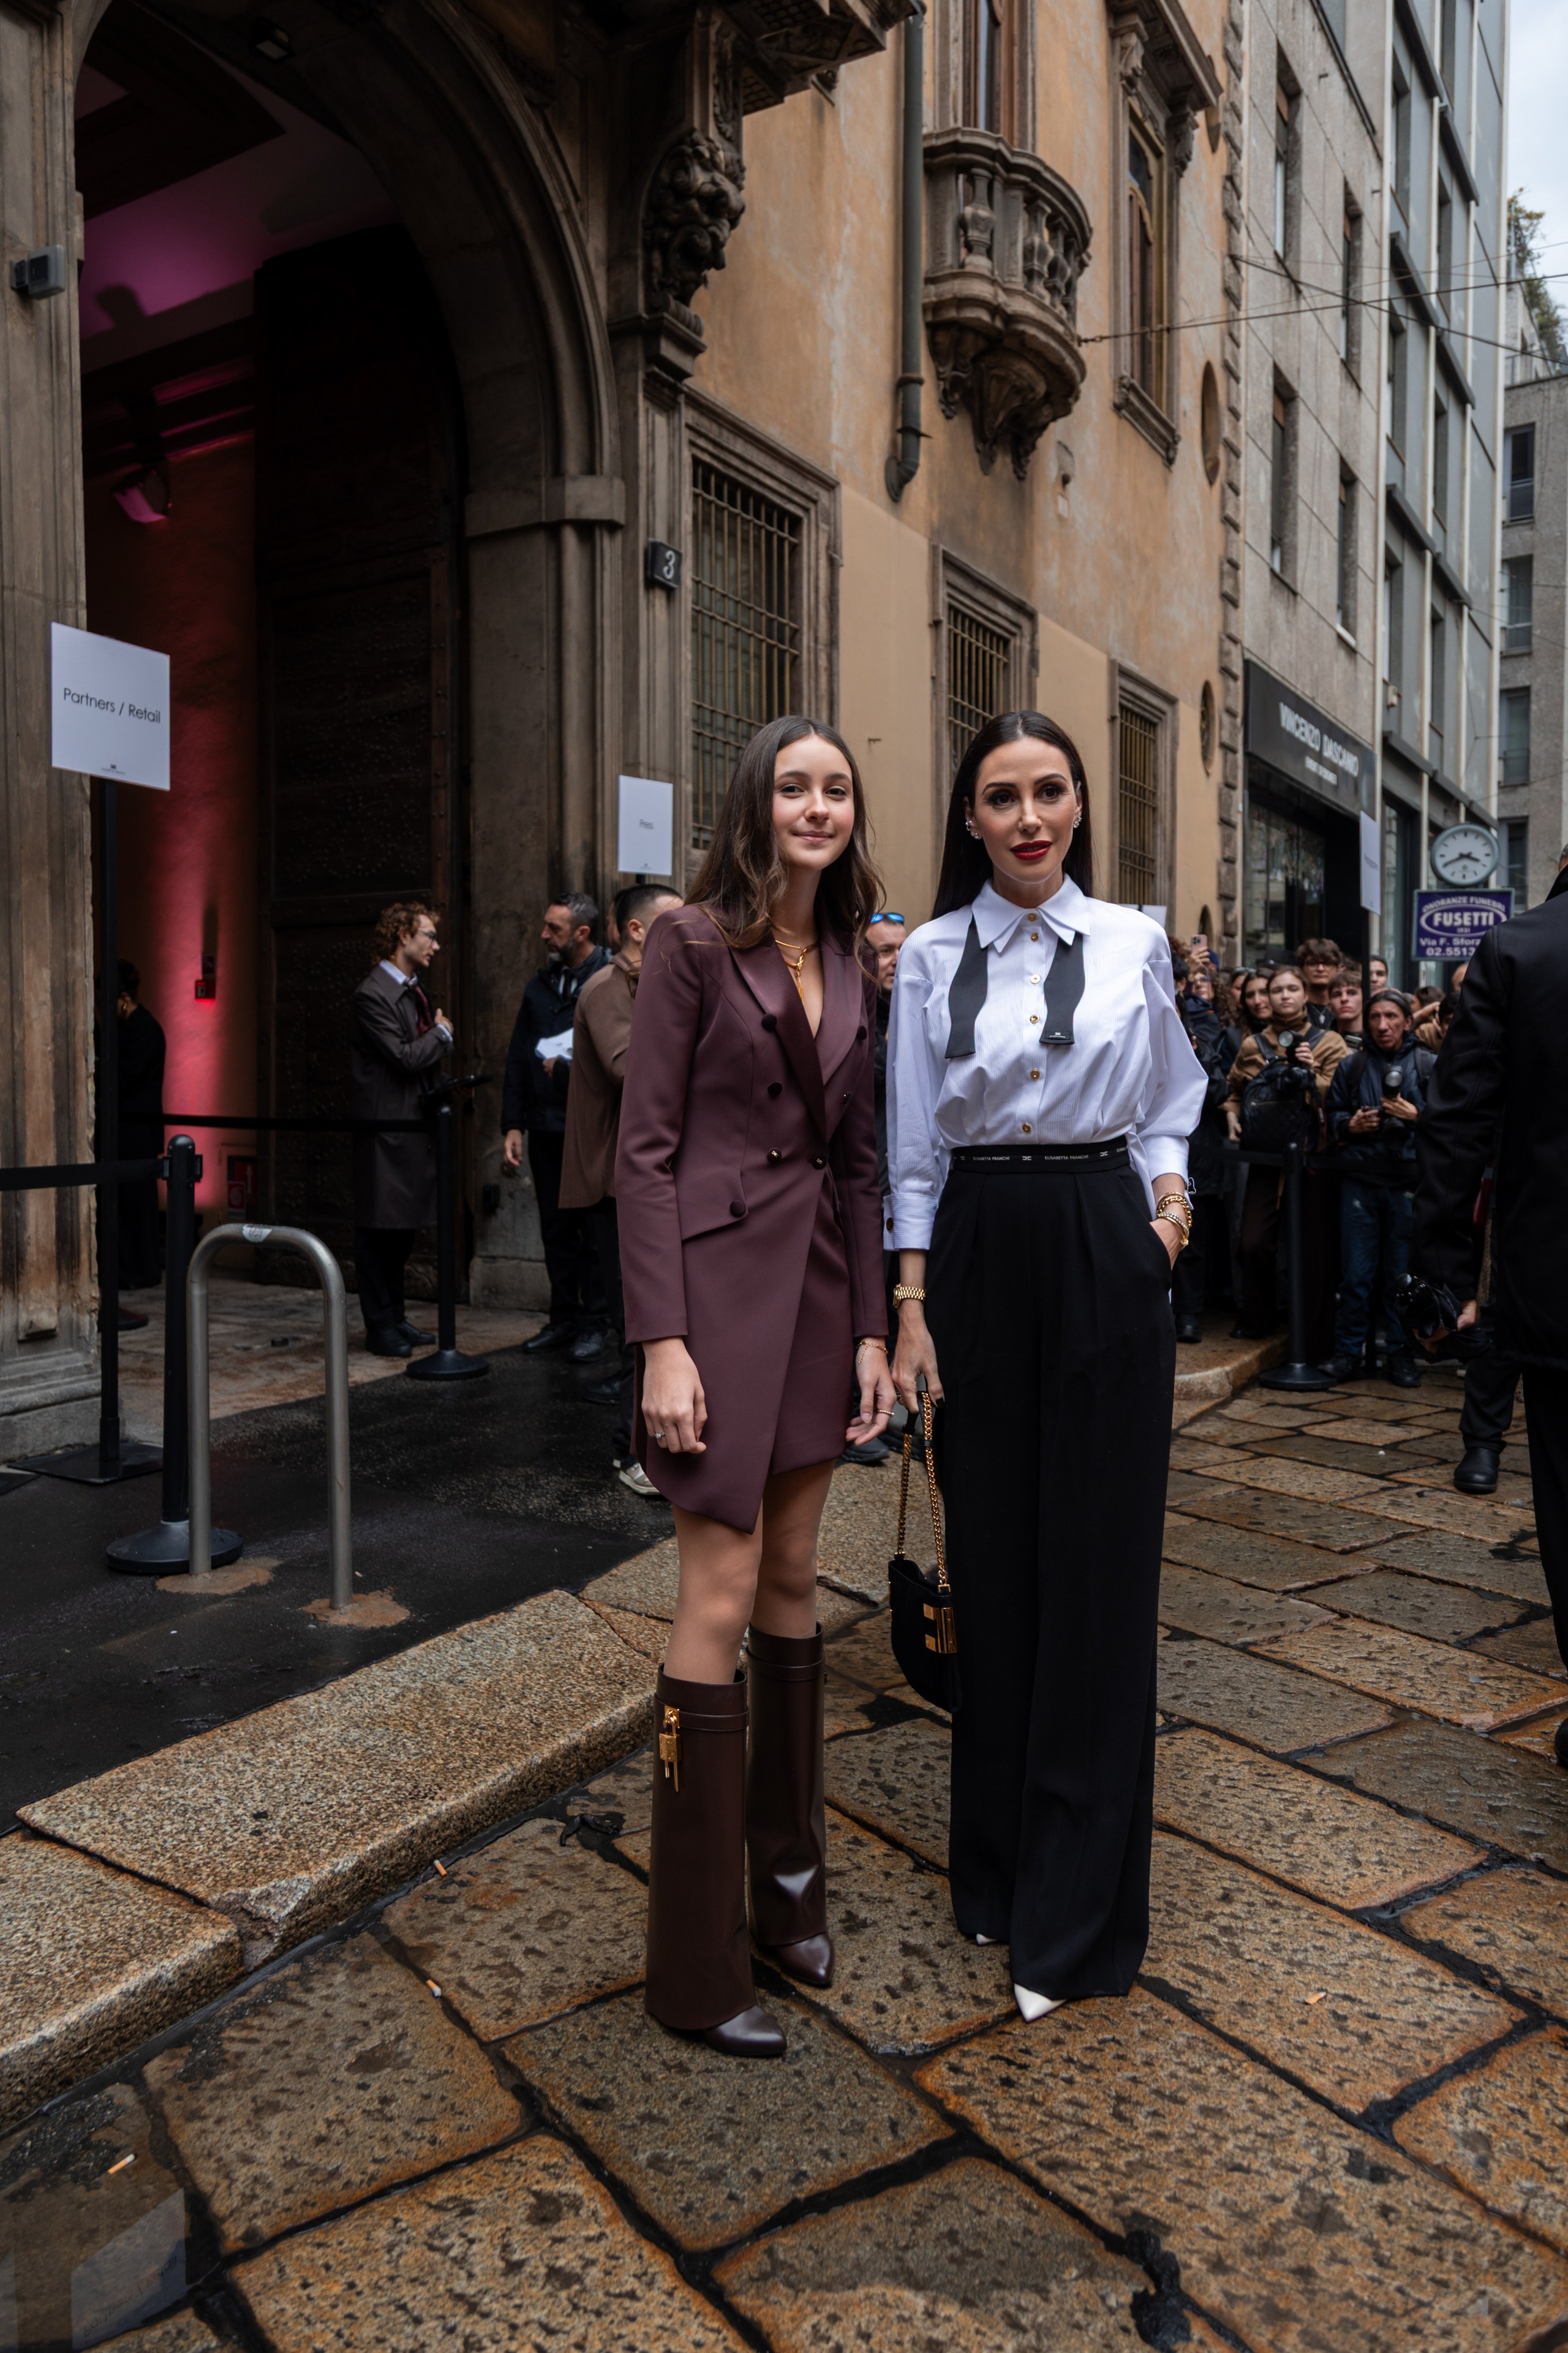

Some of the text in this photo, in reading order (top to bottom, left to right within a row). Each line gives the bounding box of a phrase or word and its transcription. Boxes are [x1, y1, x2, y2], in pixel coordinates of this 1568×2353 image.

[663, 550, 675, 580] 3
[64, 687, 160, 723] Partners / Retail
[1279, 701, 1321, 752] VINCENZO
[1422, 896, 1505, 913] ONORANZE FUNEBRI
[1433, 912, 1494, 927] FUSETTI
[1452, 937, 1481, 946] Sforz
[1426, 947, 1476, 956] 02.5513
